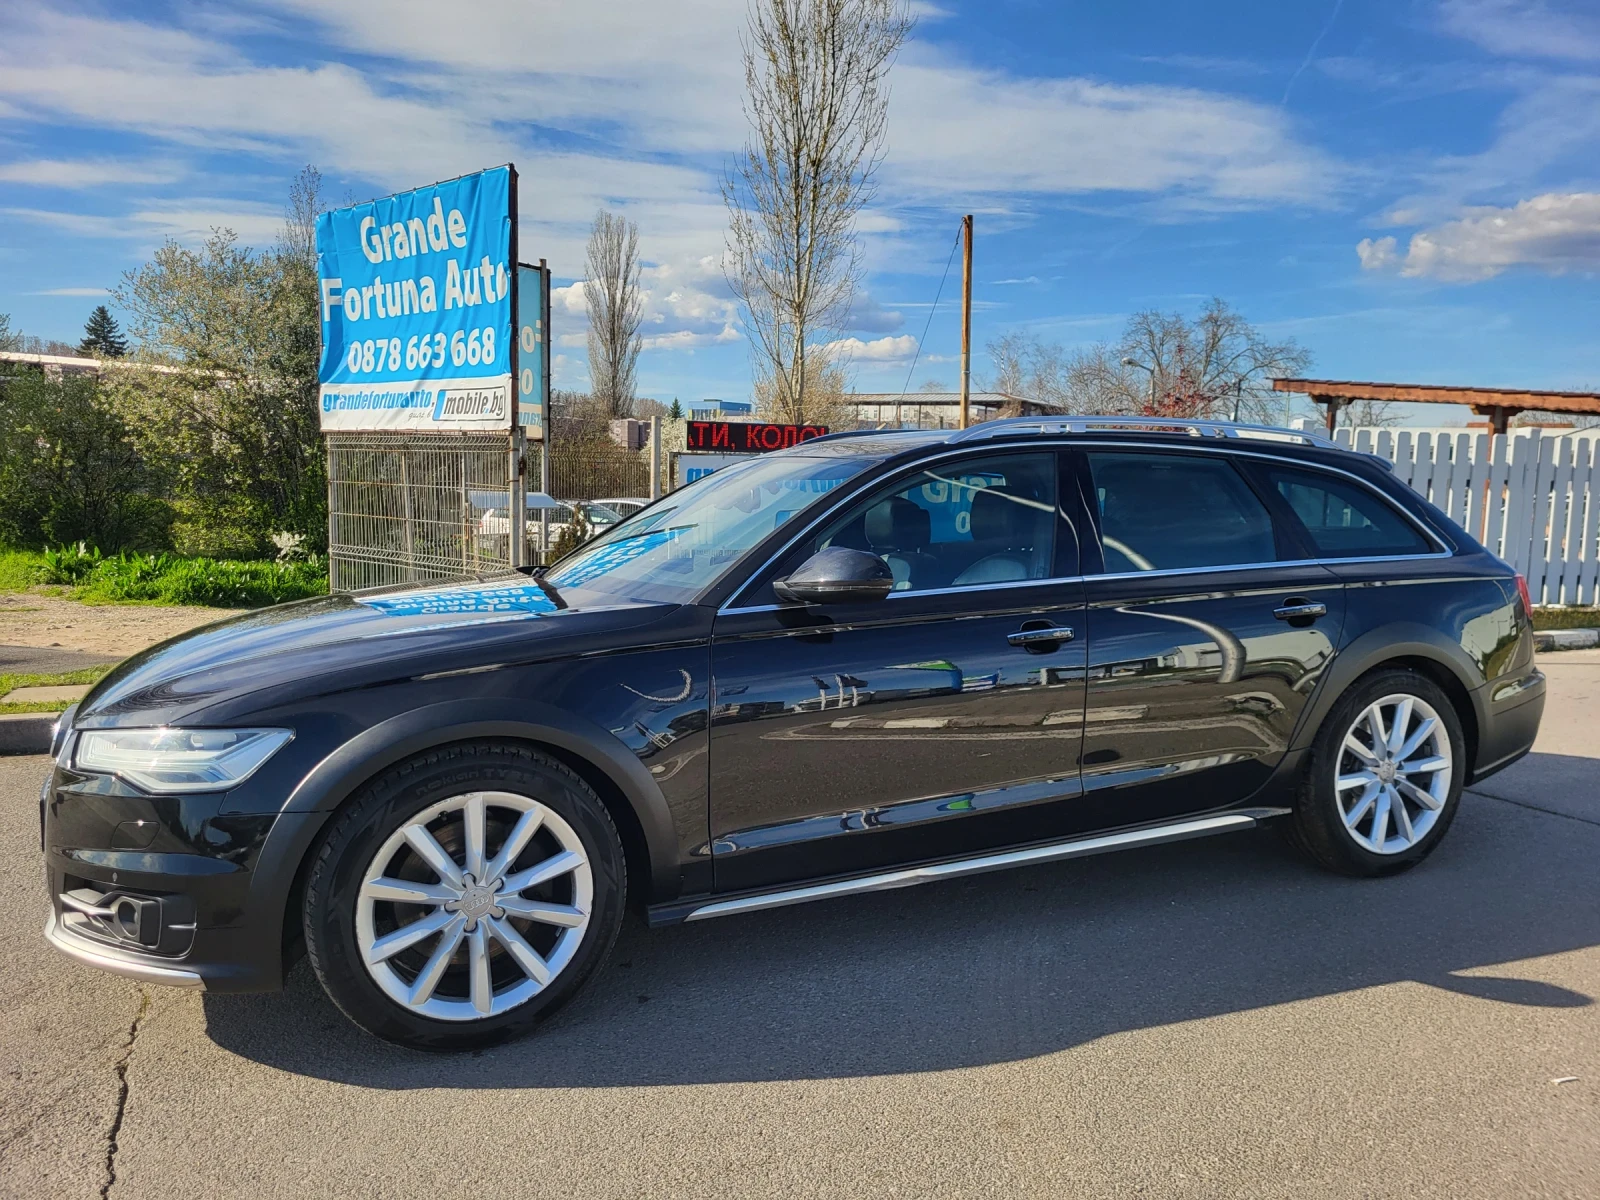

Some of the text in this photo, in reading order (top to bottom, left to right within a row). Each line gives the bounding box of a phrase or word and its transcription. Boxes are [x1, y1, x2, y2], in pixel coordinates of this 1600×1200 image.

[360, 196, 467, 264] Grande
[321, 255, 509, 322] Fortuna Auto
[347, 337, 402, 374] 0878
[405, 332, 447, 371] 663
[451, 326, 496, 367] 668
[444, 391, 503, 416] mobile.bg
[747, 425, 825, 449] КОЛО
